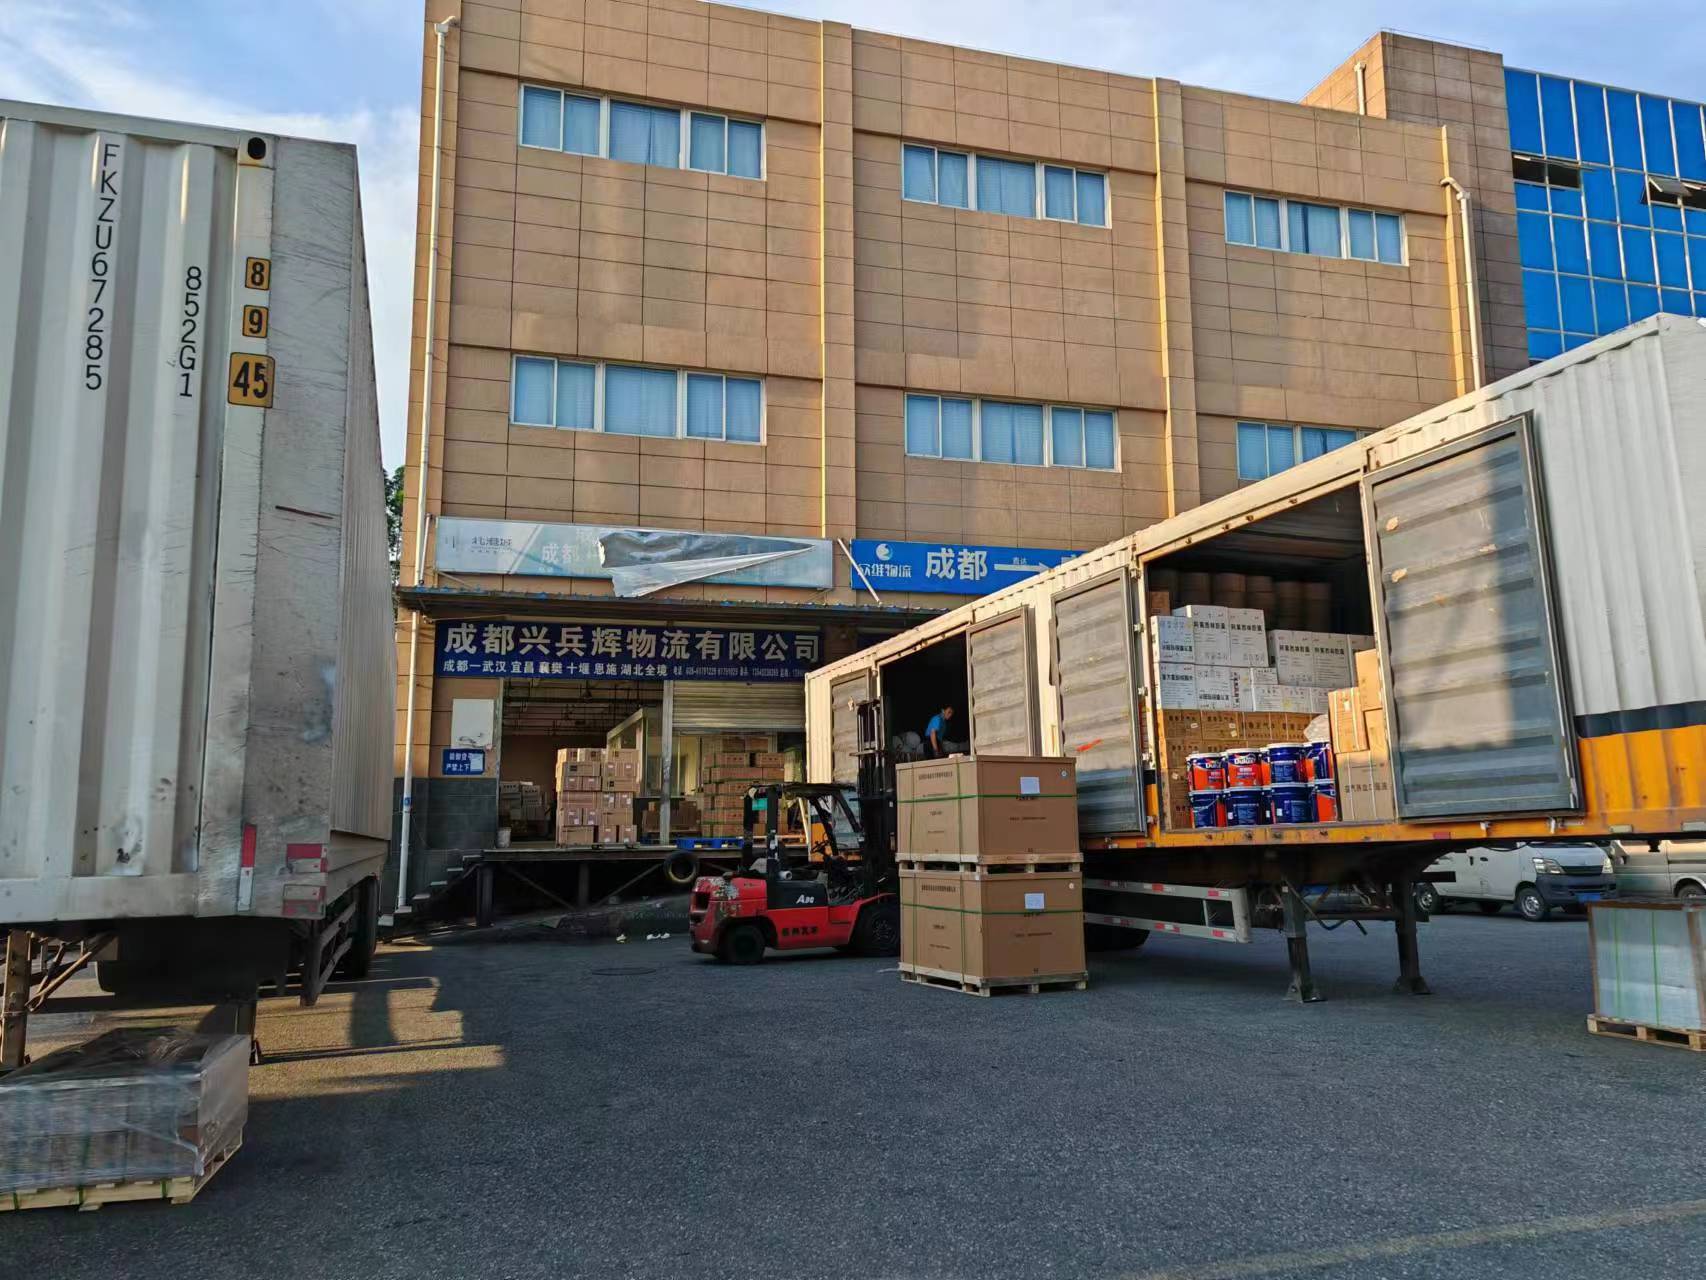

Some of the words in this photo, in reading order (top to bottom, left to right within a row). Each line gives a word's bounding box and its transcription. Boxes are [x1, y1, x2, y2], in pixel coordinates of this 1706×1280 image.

[251, 261, 265, 287] 8
[179, 265, 202, 398] 852G1
[248, 308, 263, 335] 9
[233, 360, 268, 399] 45
[925, 547, 988, 581] 成都
[444, 622, 819, 663] 成都兴兵辉物流有限公司
[511, 661, 534, 674] 宜昌
[539, 661, 563, 674] 襄樊
[566, 662, 590, 675] 十堰
[594, 663, 617, 676] 恩施
[620, 664, 668, 677] 湖北全境
